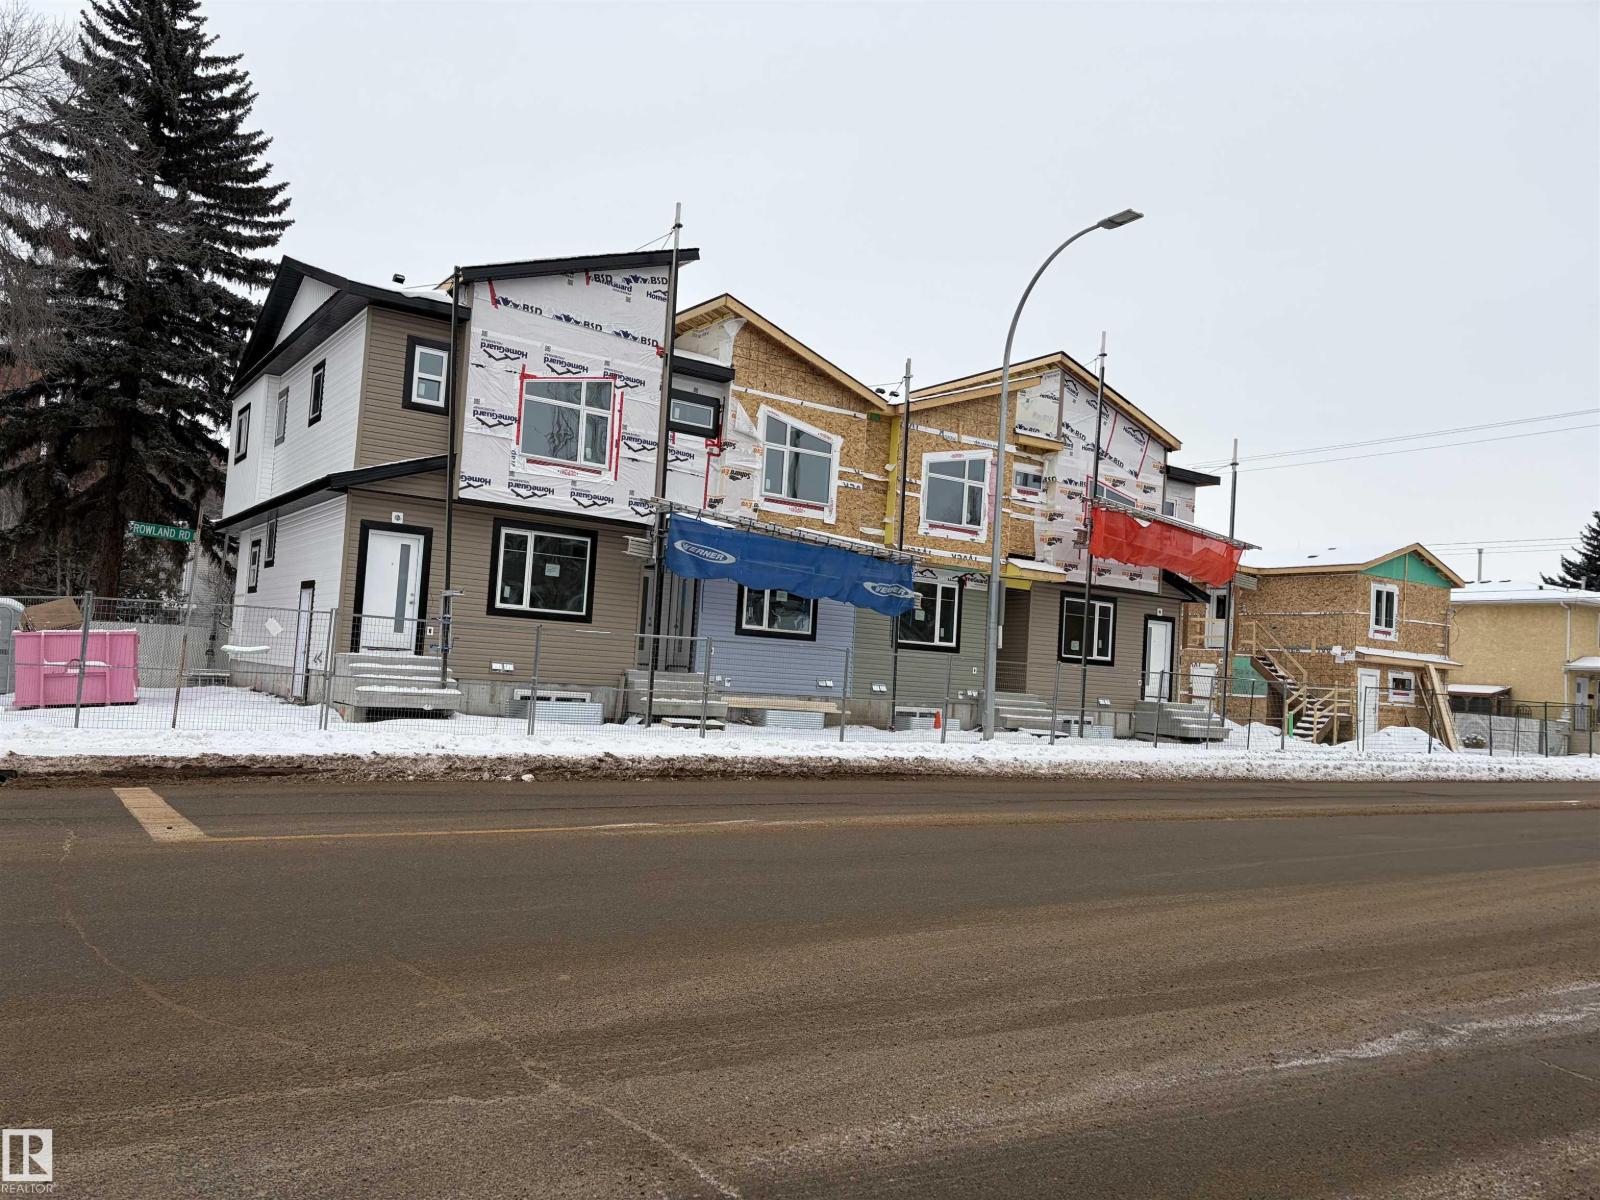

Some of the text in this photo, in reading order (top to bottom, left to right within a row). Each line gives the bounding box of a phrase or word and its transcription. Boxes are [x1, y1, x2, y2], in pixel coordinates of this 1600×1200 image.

[650, 276, 668, 284] BSD
[523, 304, 542, 315] BSD
[640, 337, 658, 347] BSD
[480, 342, 528, 359] HomeGuard
[544, 356, 588, 373] HomeGuard
[622, 435, 658, 447] omeGuard
[460, 475, 491, 486] HomeG
[508, 481, 554, 495] HomeGuard
[570, 491, 614, 504] HomeGuard
[133, 523, 191, 540] ROWLAND RD
[681, 543, 725, 561] WERNER
